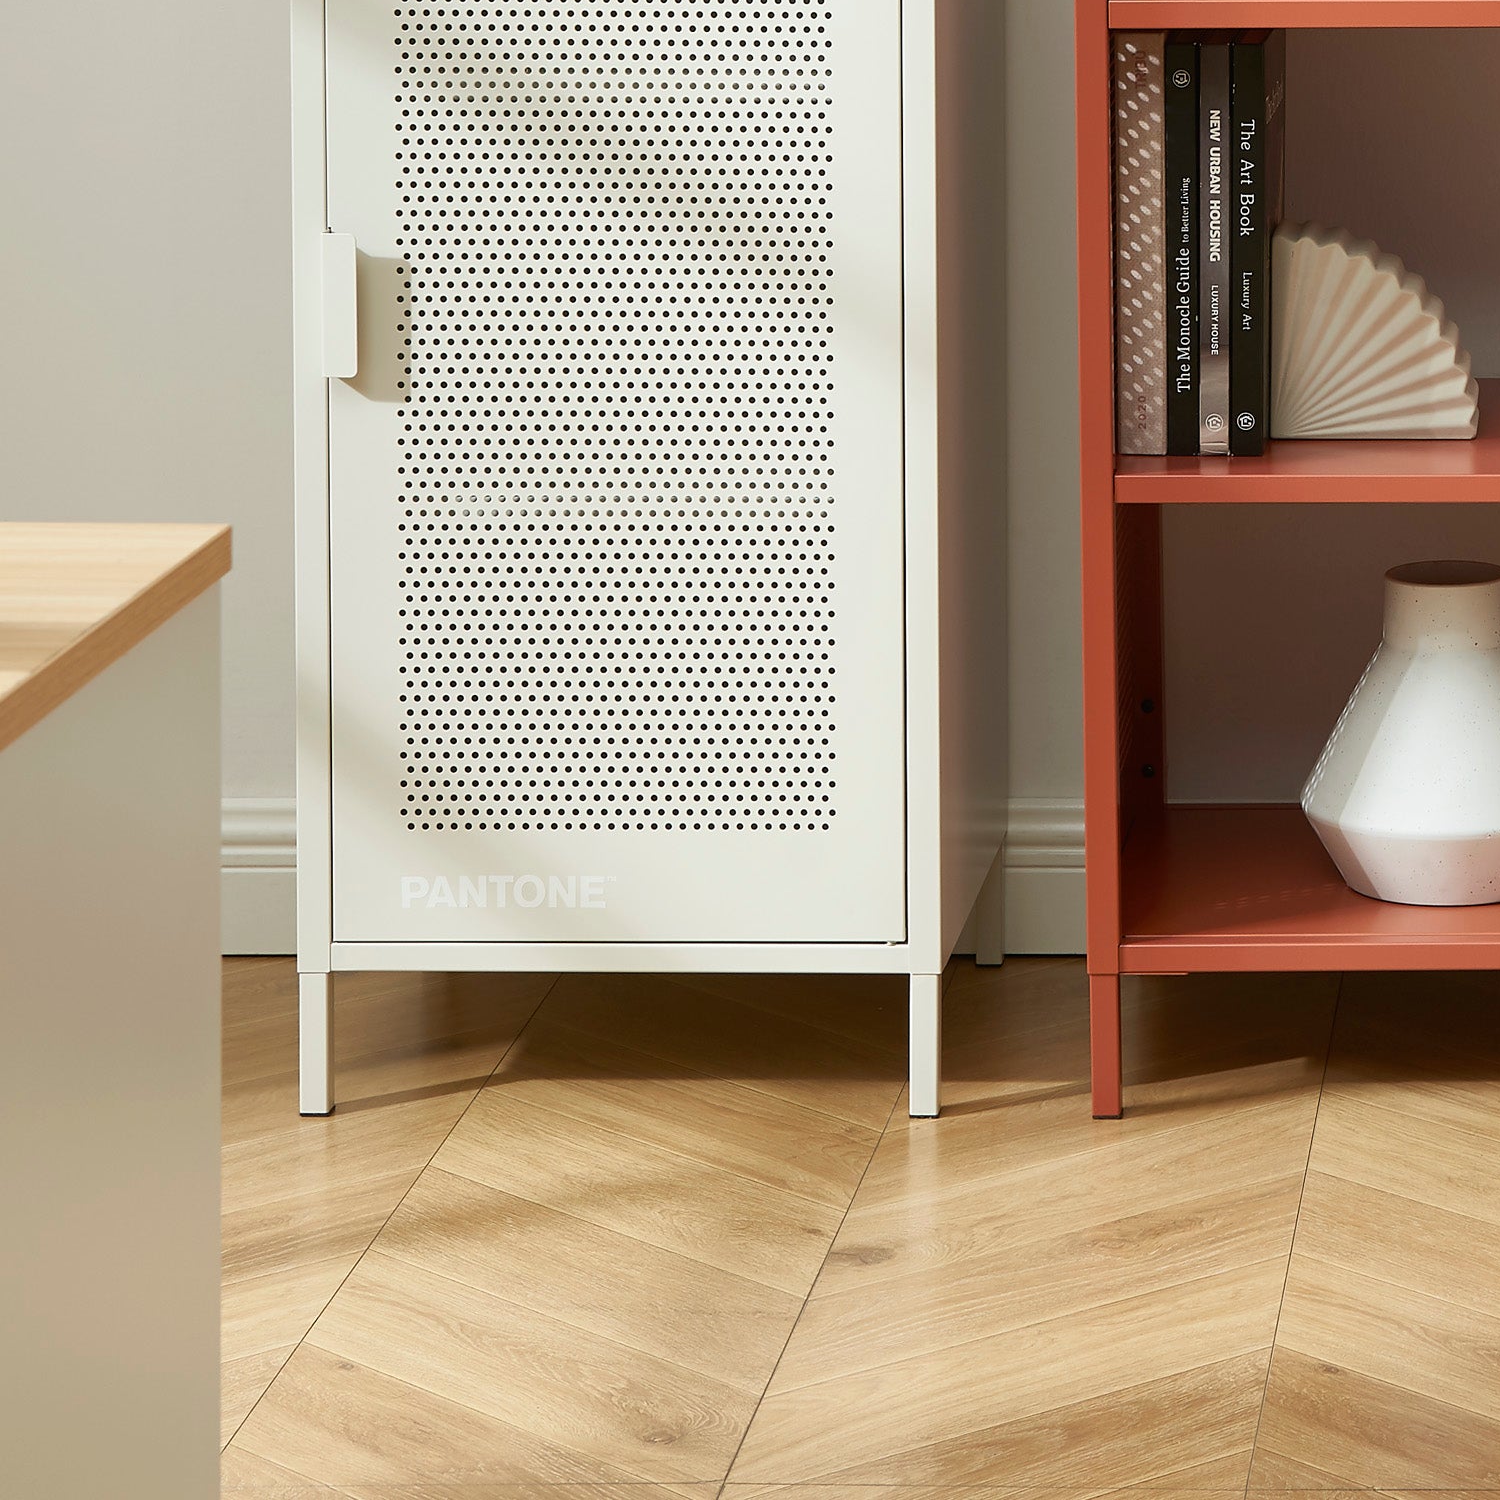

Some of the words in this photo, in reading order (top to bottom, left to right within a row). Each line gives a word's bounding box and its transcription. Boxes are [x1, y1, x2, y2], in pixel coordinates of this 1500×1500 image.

[1209, 109, 1221, 142] NEW
[1240, 119, 1255, 151] The
[1209, 147, 1221, 194] URBAN
[1240, 159, 1255, 185] Art
[1180, 177, 1191, 205] Living
[1180, 205, 1190, 232] Better
[1209, 200, 1221, 263] HOUSING
[1240, 194, 1255, 236] Book
[1181, 233, 1190, 243] to
[1175, 248, 1191, 293] Guide
[1211, 285, 1219, 322] LUXURY
[1241, 272, 1253, 309] Luxury
[1175, 296, 1191, 361] Monocle
[1242, 313, 1253, 331] Art
[1211, 323, 1219, 356] HOUSE
[1175, 363, 1191, 393] The
[1137, 396, 1147, 430] 2020
[400, 874, 607, 909] PANTONE
